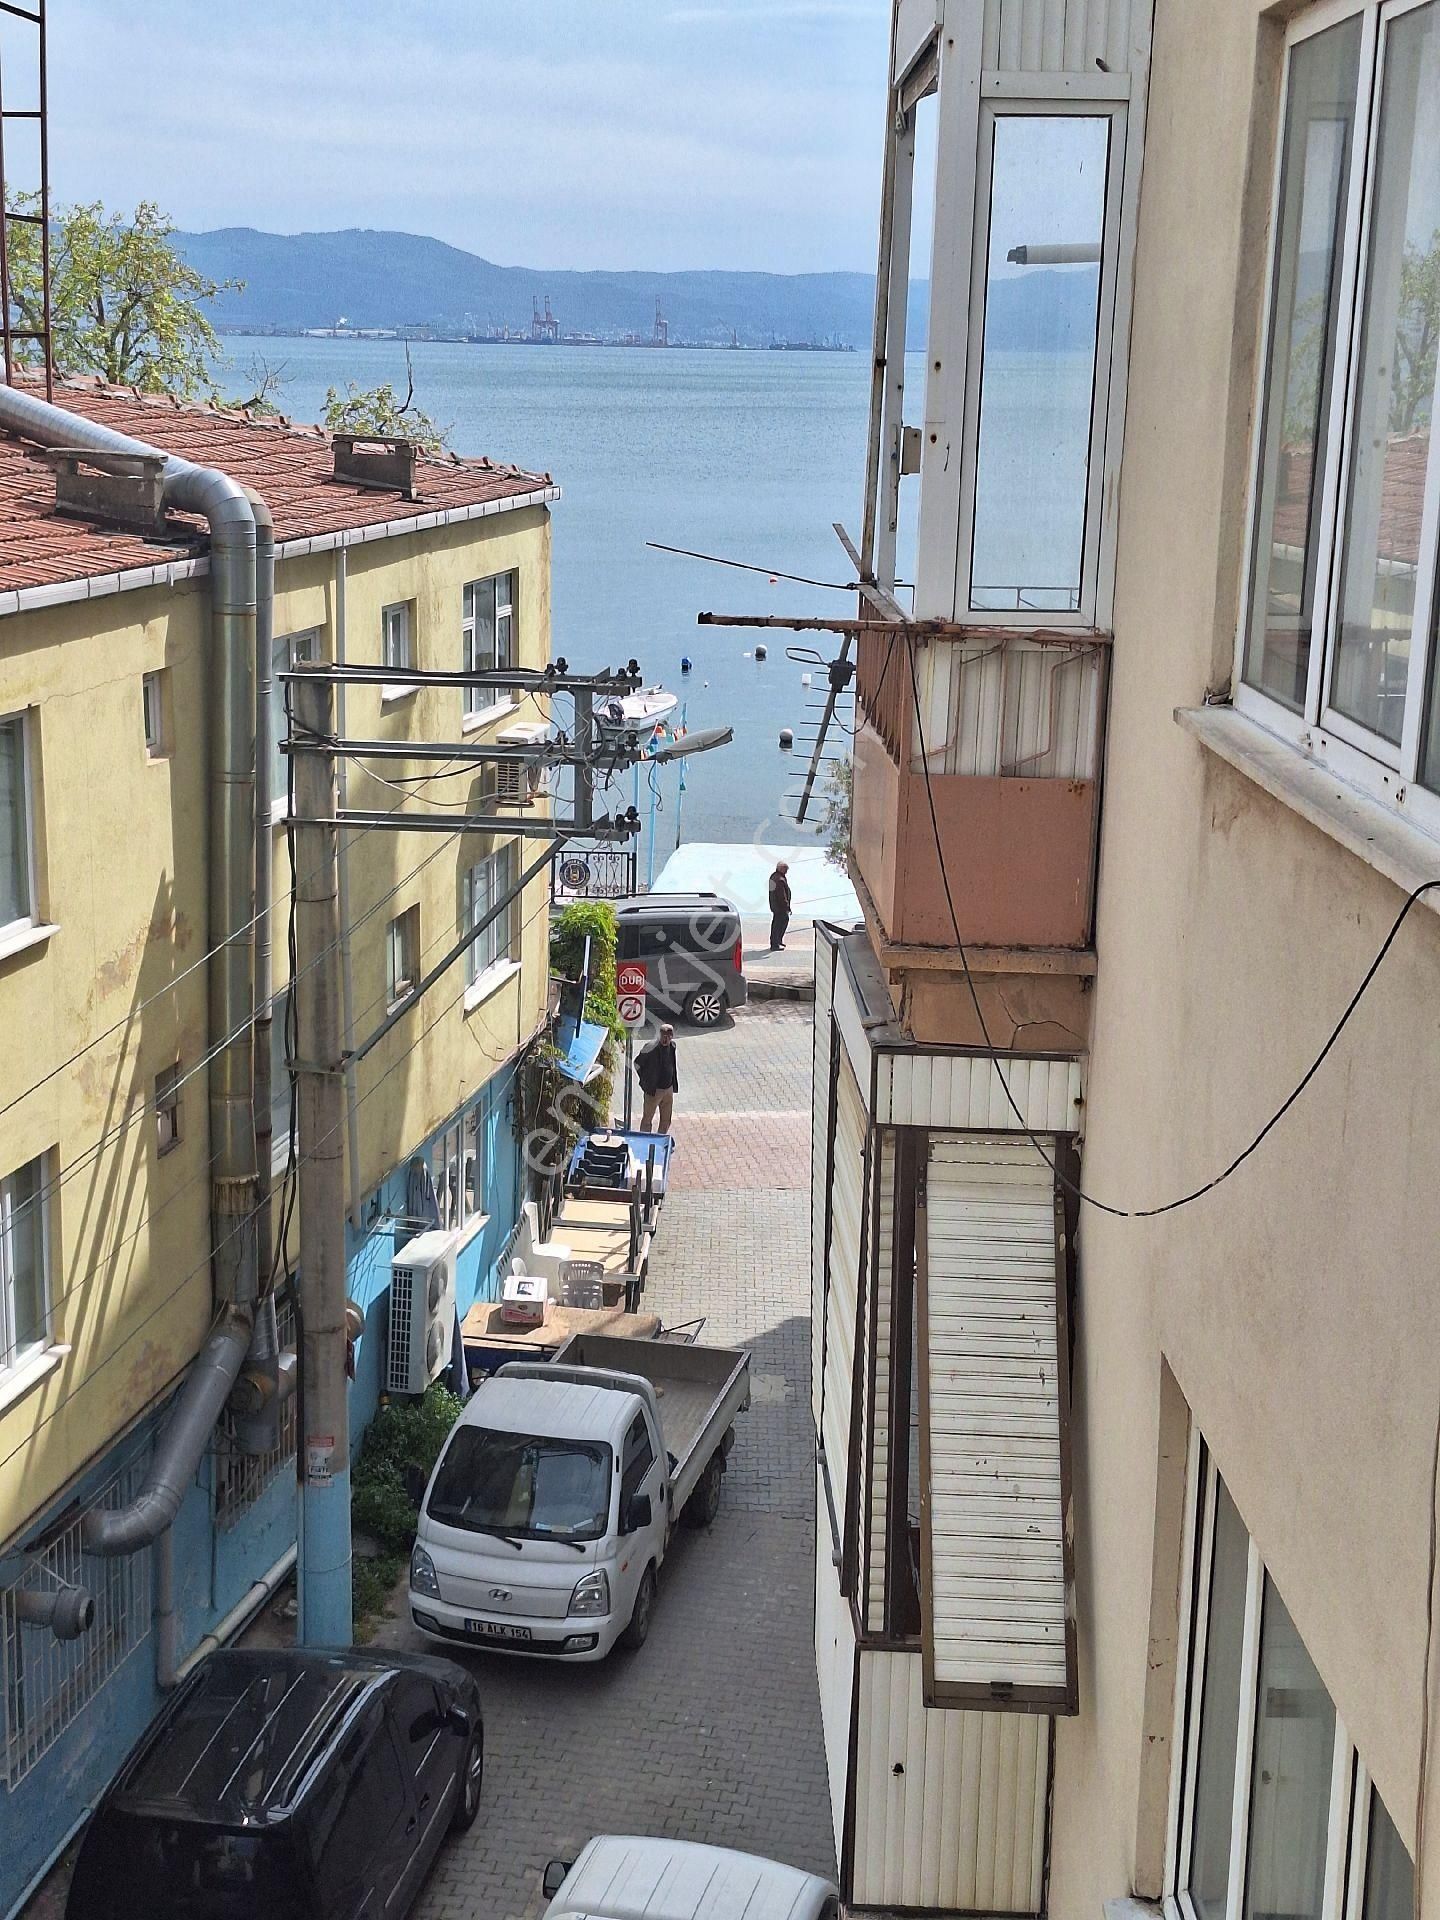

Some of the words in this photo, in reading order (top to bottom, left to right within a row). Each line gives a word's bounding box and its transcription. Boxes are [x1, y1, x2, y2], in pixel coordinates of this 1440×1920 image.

[621, 975, 643, 985] DUR
[472, 1622, 484, 1632] 16
[487, 1623, 506, 1635] ALK
[511, 1628, 529, 1639] 154
